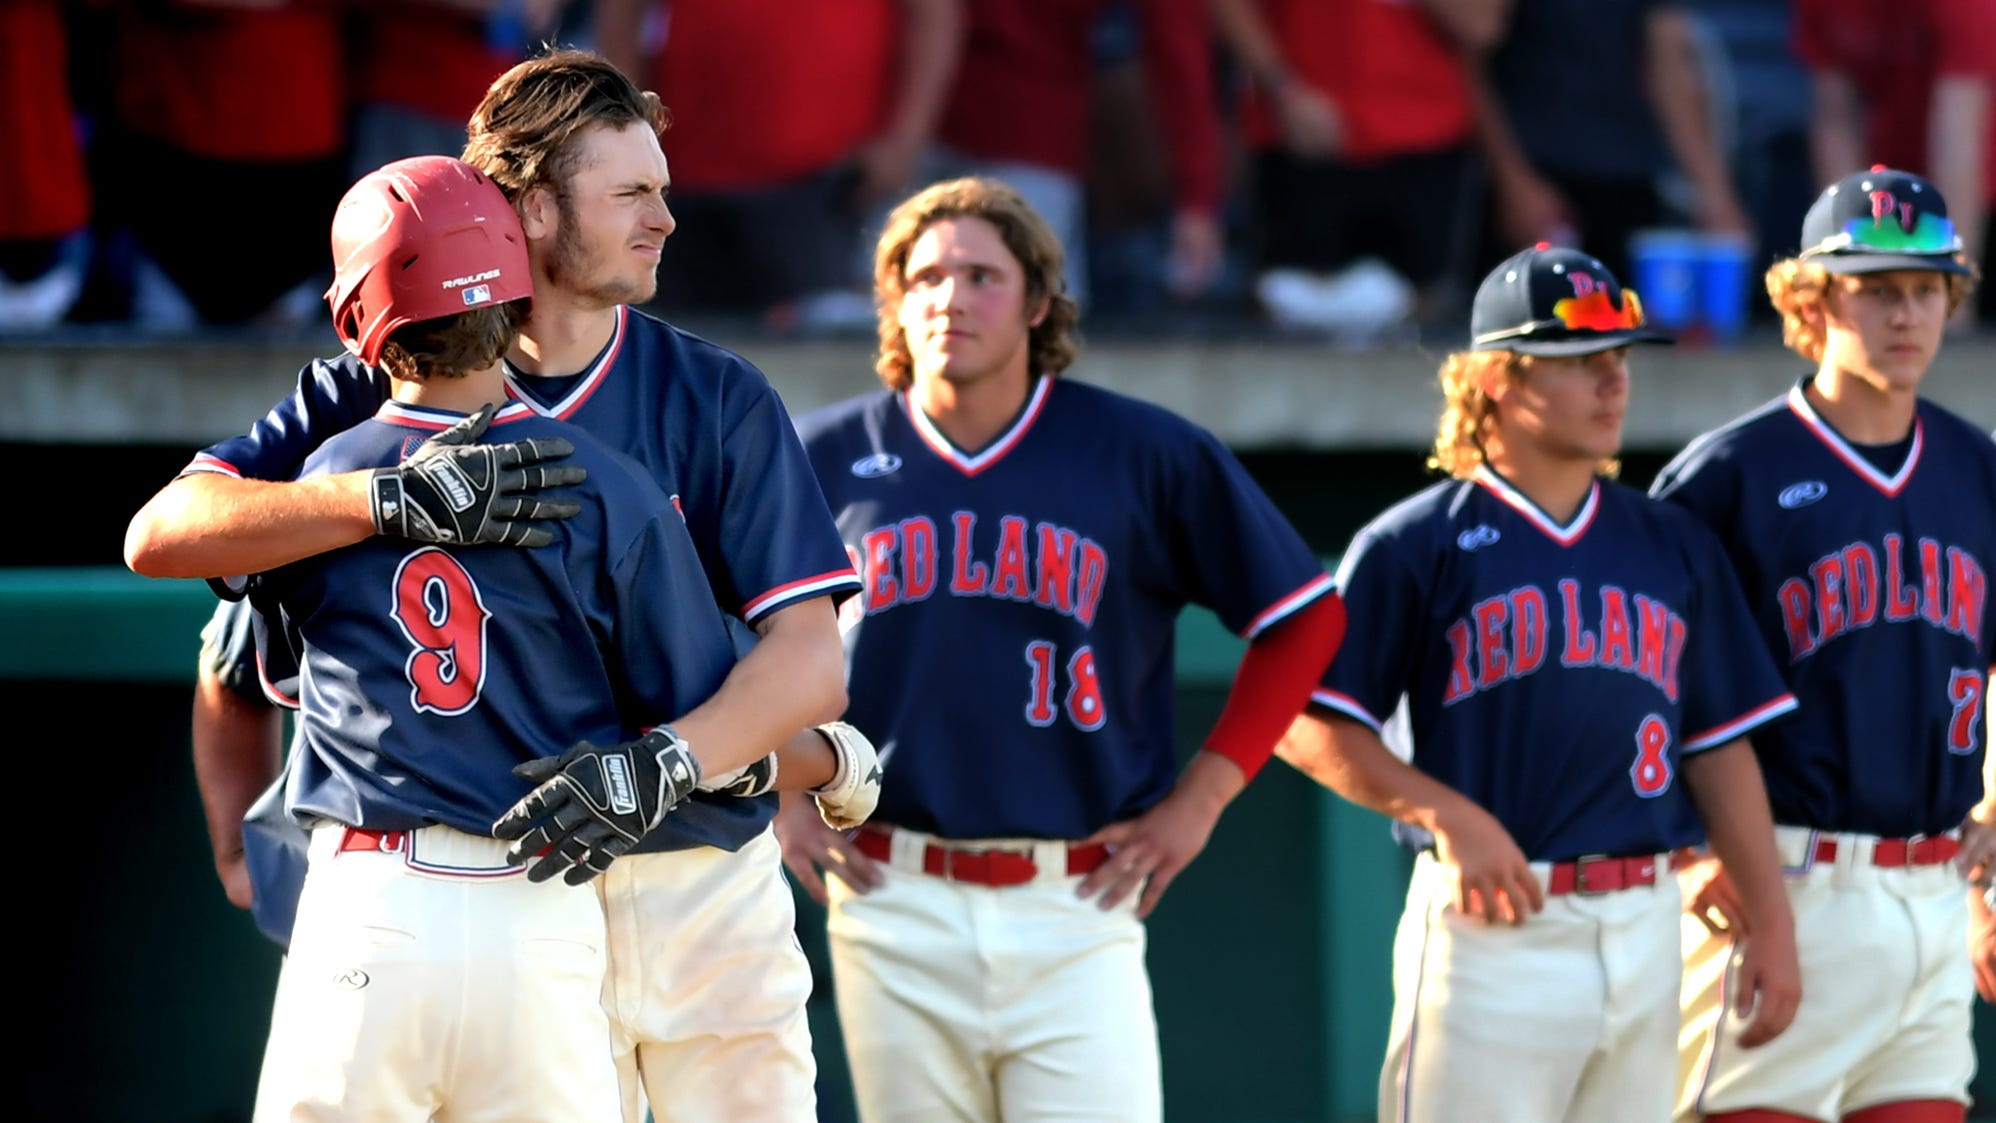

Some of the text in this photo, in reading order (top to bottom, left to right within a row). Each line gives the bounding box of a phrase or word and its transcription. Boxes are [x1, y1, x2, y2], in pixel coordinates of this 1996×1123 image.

[442, 268, 502, 290] RAWLINGS
[951, 510, 1109, 630] LAND
[1777, 541, 1878, 662] RED
[389, 545, 493, 717] 9
[1025, 640, 1107, 732] 18
[1948, 667, 1983, 756] 7
[1629, 713, 1673, 799] 8
